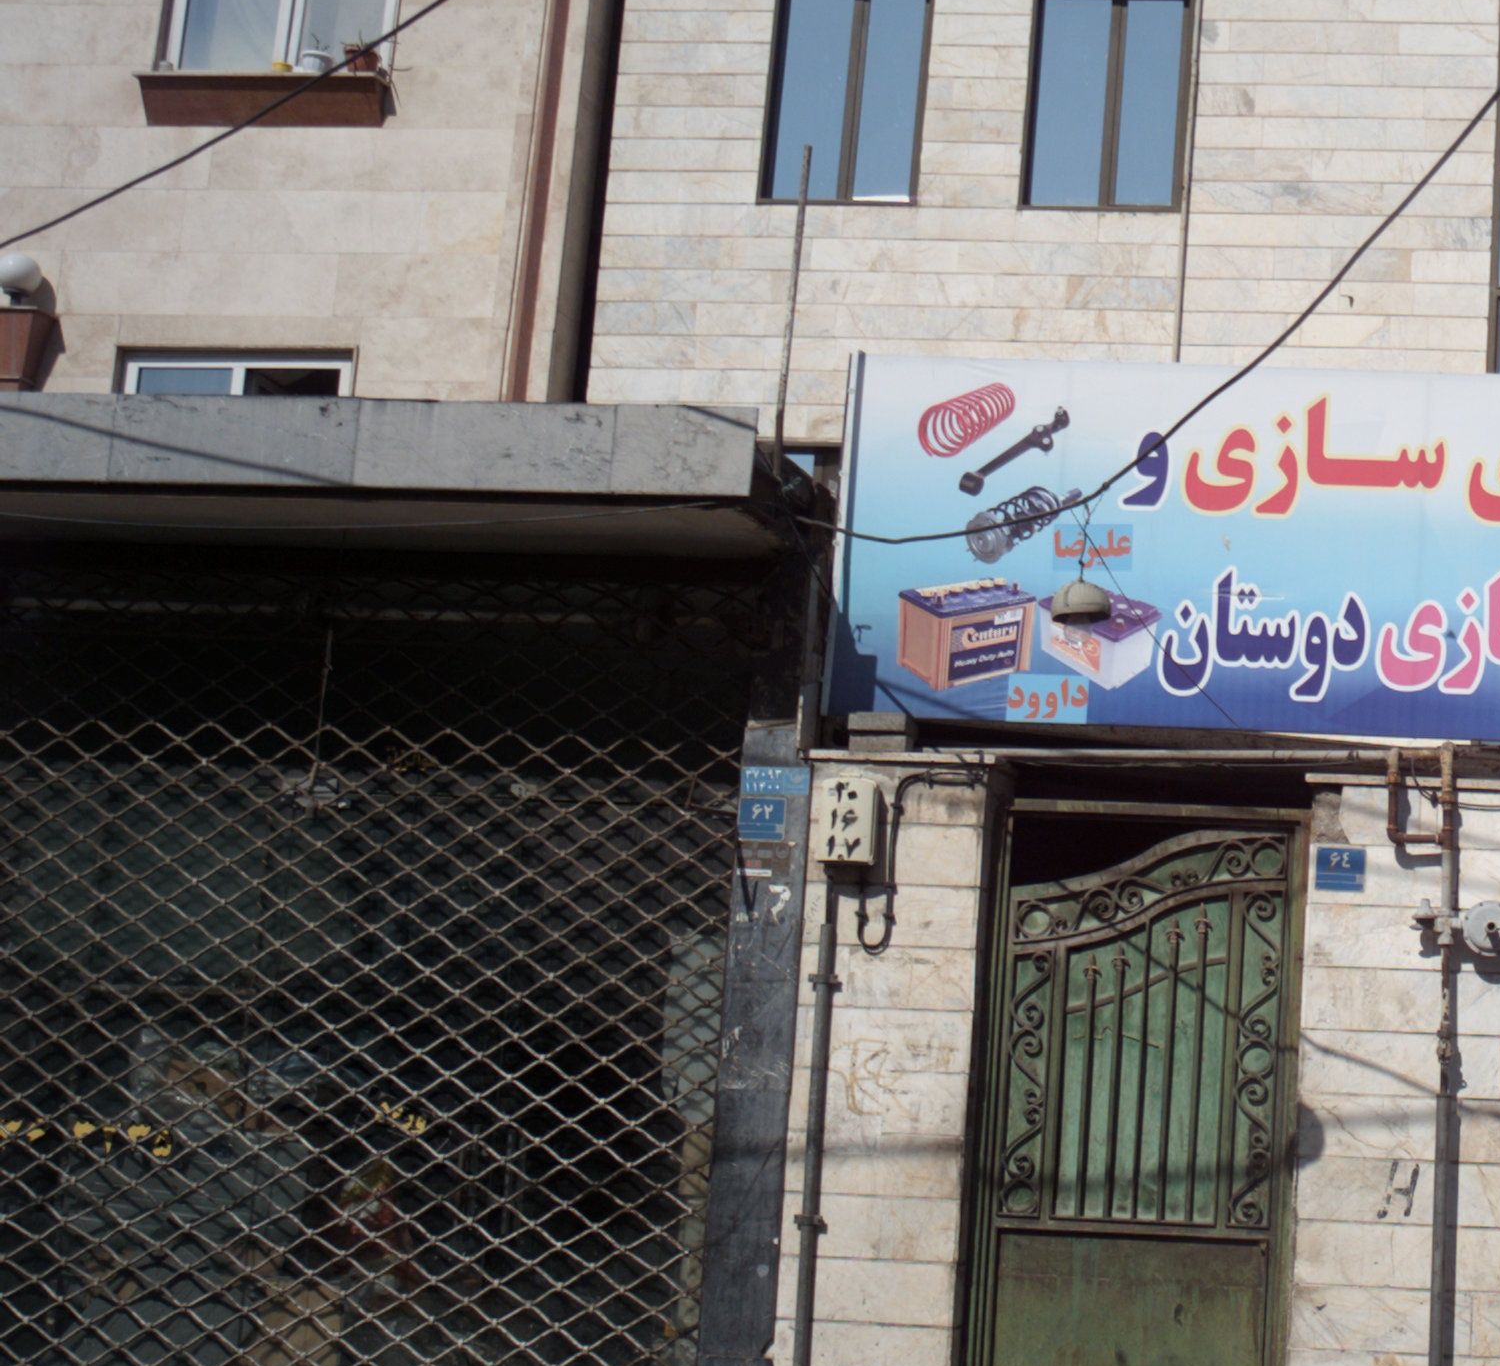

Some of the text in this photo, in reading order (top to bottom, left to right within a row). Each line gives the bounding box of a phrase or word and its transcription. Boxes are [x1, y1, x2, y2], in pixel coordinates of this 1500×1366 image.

[1121, 431, 1170, 508] و
[1184, 395, 1447, 516] سازی
[1053, 528, 1132, 568] علیرضا
[1159, 566, 1369, 702] دوستان
[1007, 678, 1089, 720] داوود
